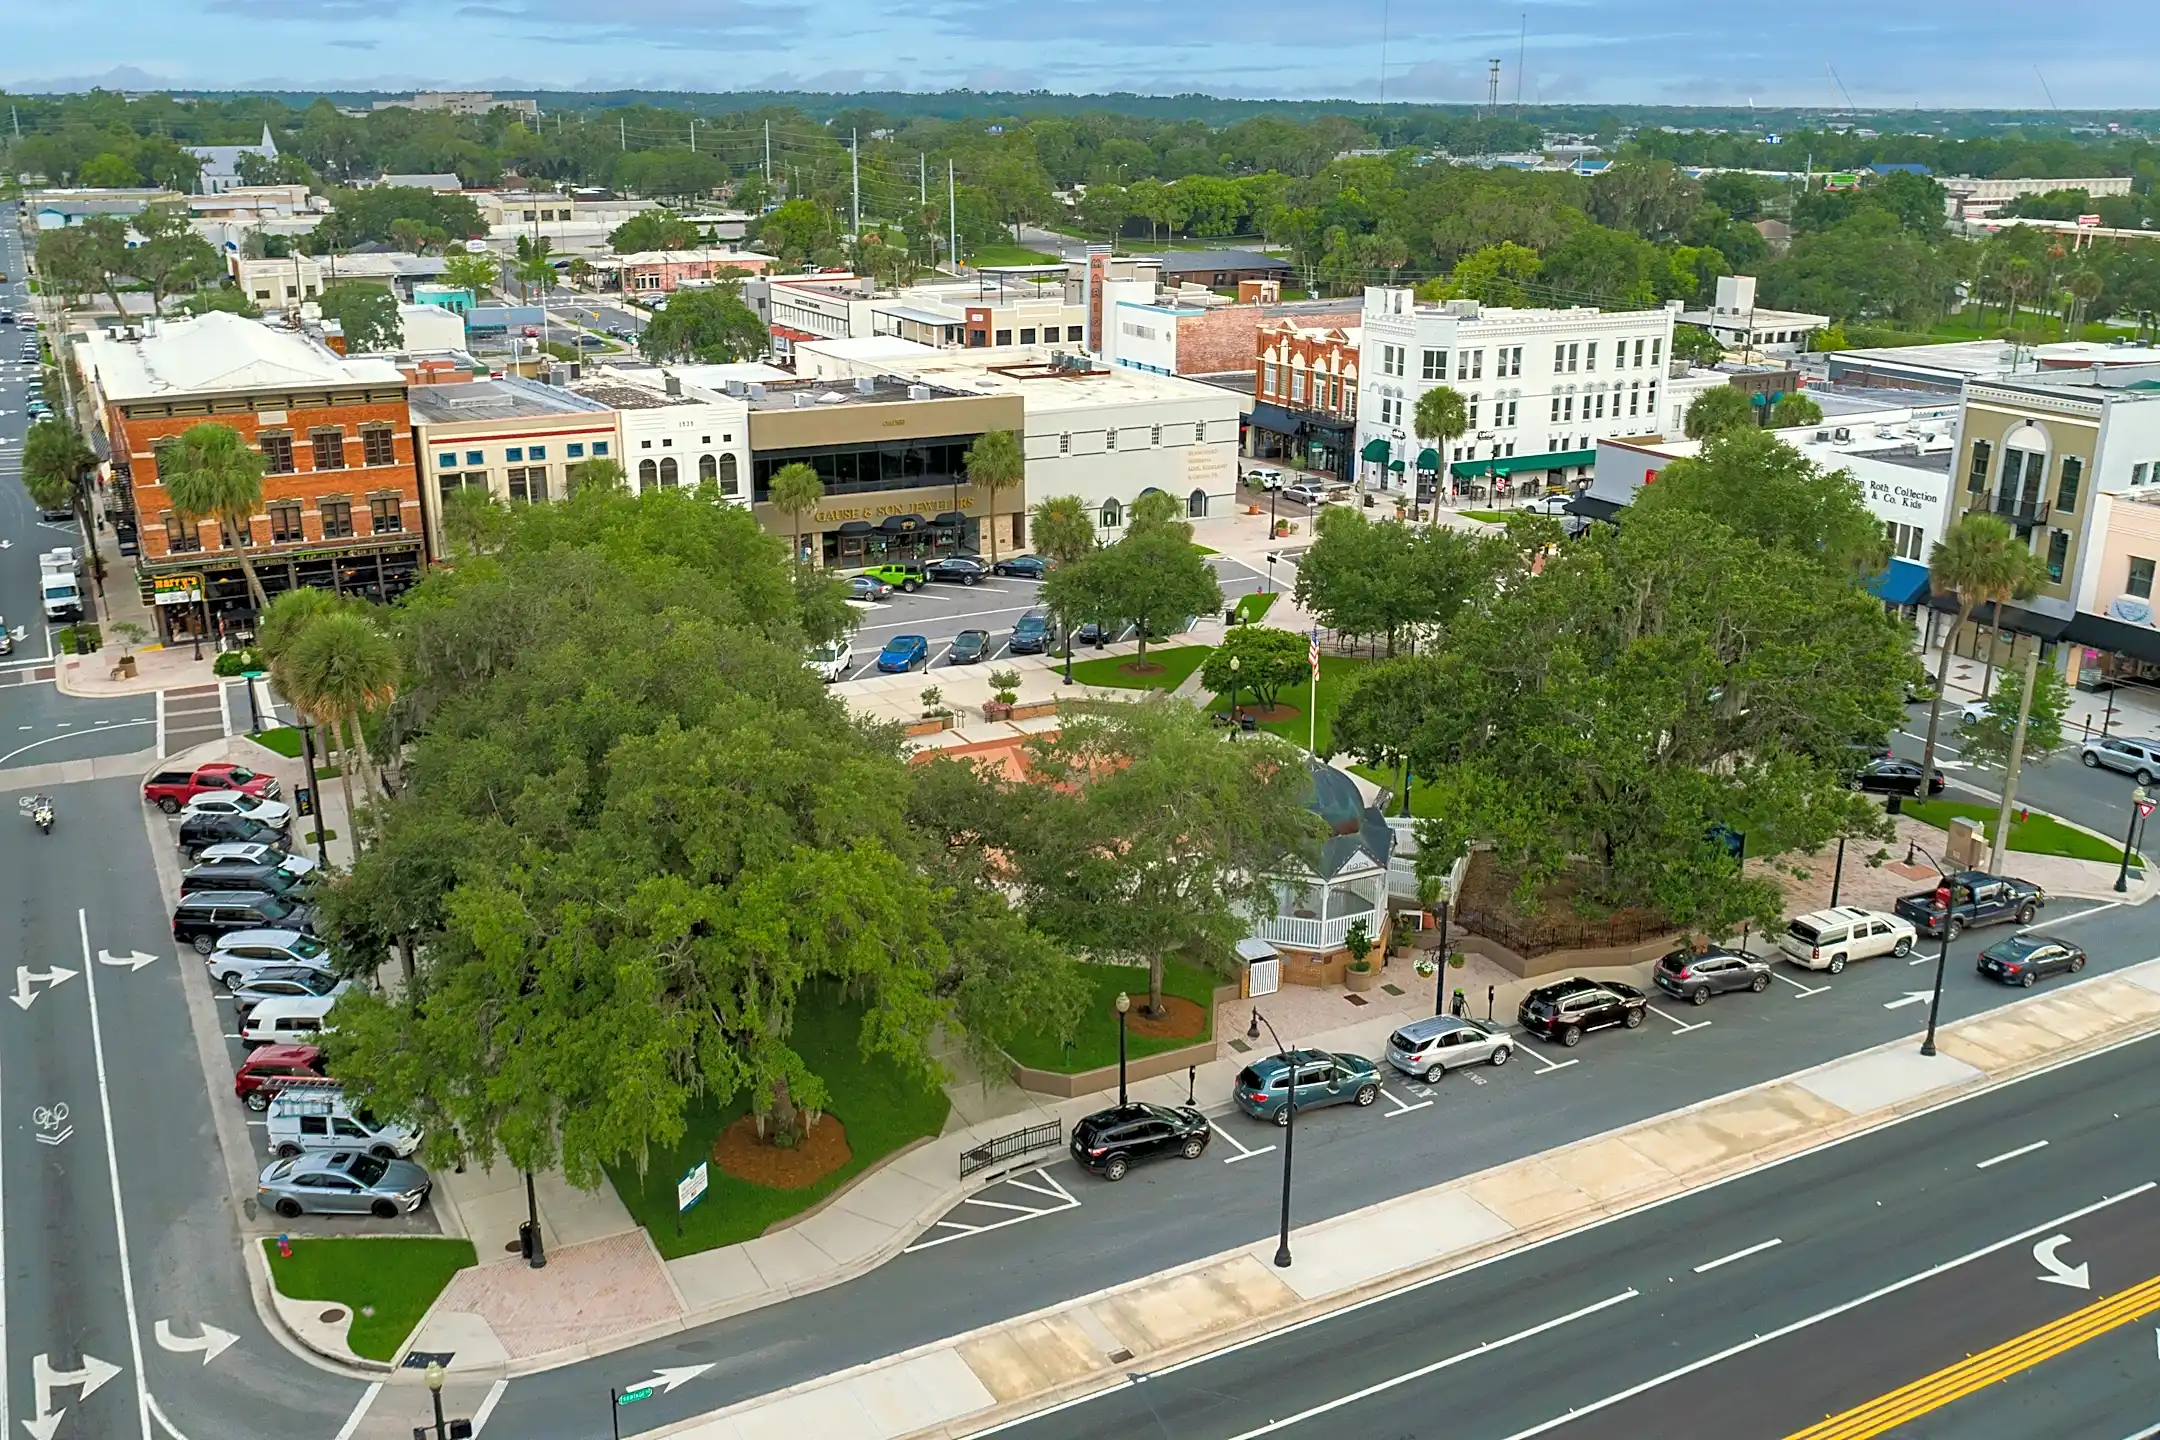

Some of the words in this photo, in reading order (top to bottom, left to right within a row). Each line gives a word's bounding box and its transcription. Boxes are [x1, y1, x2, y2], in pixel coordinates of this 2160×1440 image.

[1870, 480, 1889, 493] Roth
[1894, 485, 1937, 503] Collection
[1871, 490, 1878, 500] &
[1883, 493, 1897, 504] Co.
[1902, 497, 1922, 509] Kids
[815, 507, 859, 523] GAUSE
[862, 505, 873, 518] &
[876, 503, 904, 516] SON
